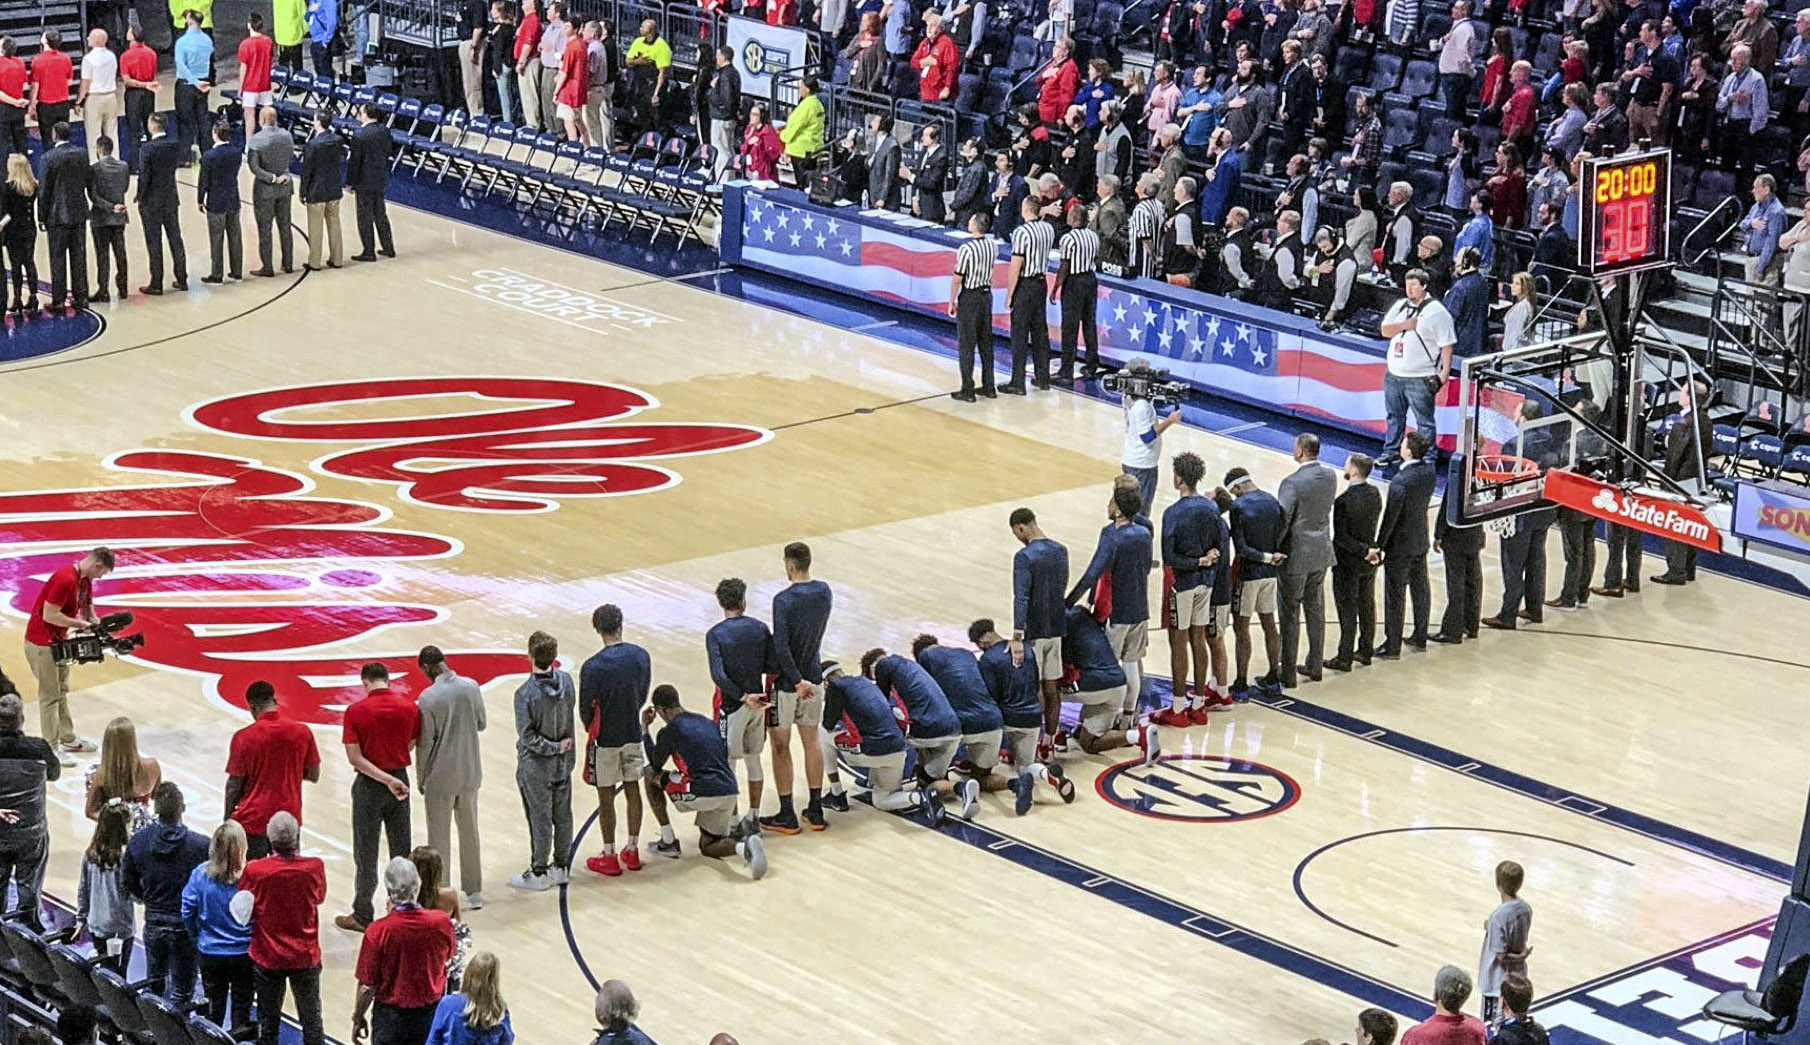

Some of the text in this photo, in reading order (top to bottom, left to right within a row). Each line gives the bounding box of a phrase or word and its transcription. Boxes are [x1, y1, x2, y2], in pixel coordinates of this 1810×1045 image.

[1597, 162, 1656, 203] 20:00
[1603, 200, 1648, 259] 30
[472, 269, 675, 327] CRADDOCK
[473, 284, 609, 321] COURT
[180, 376, 774, 514] Ole
